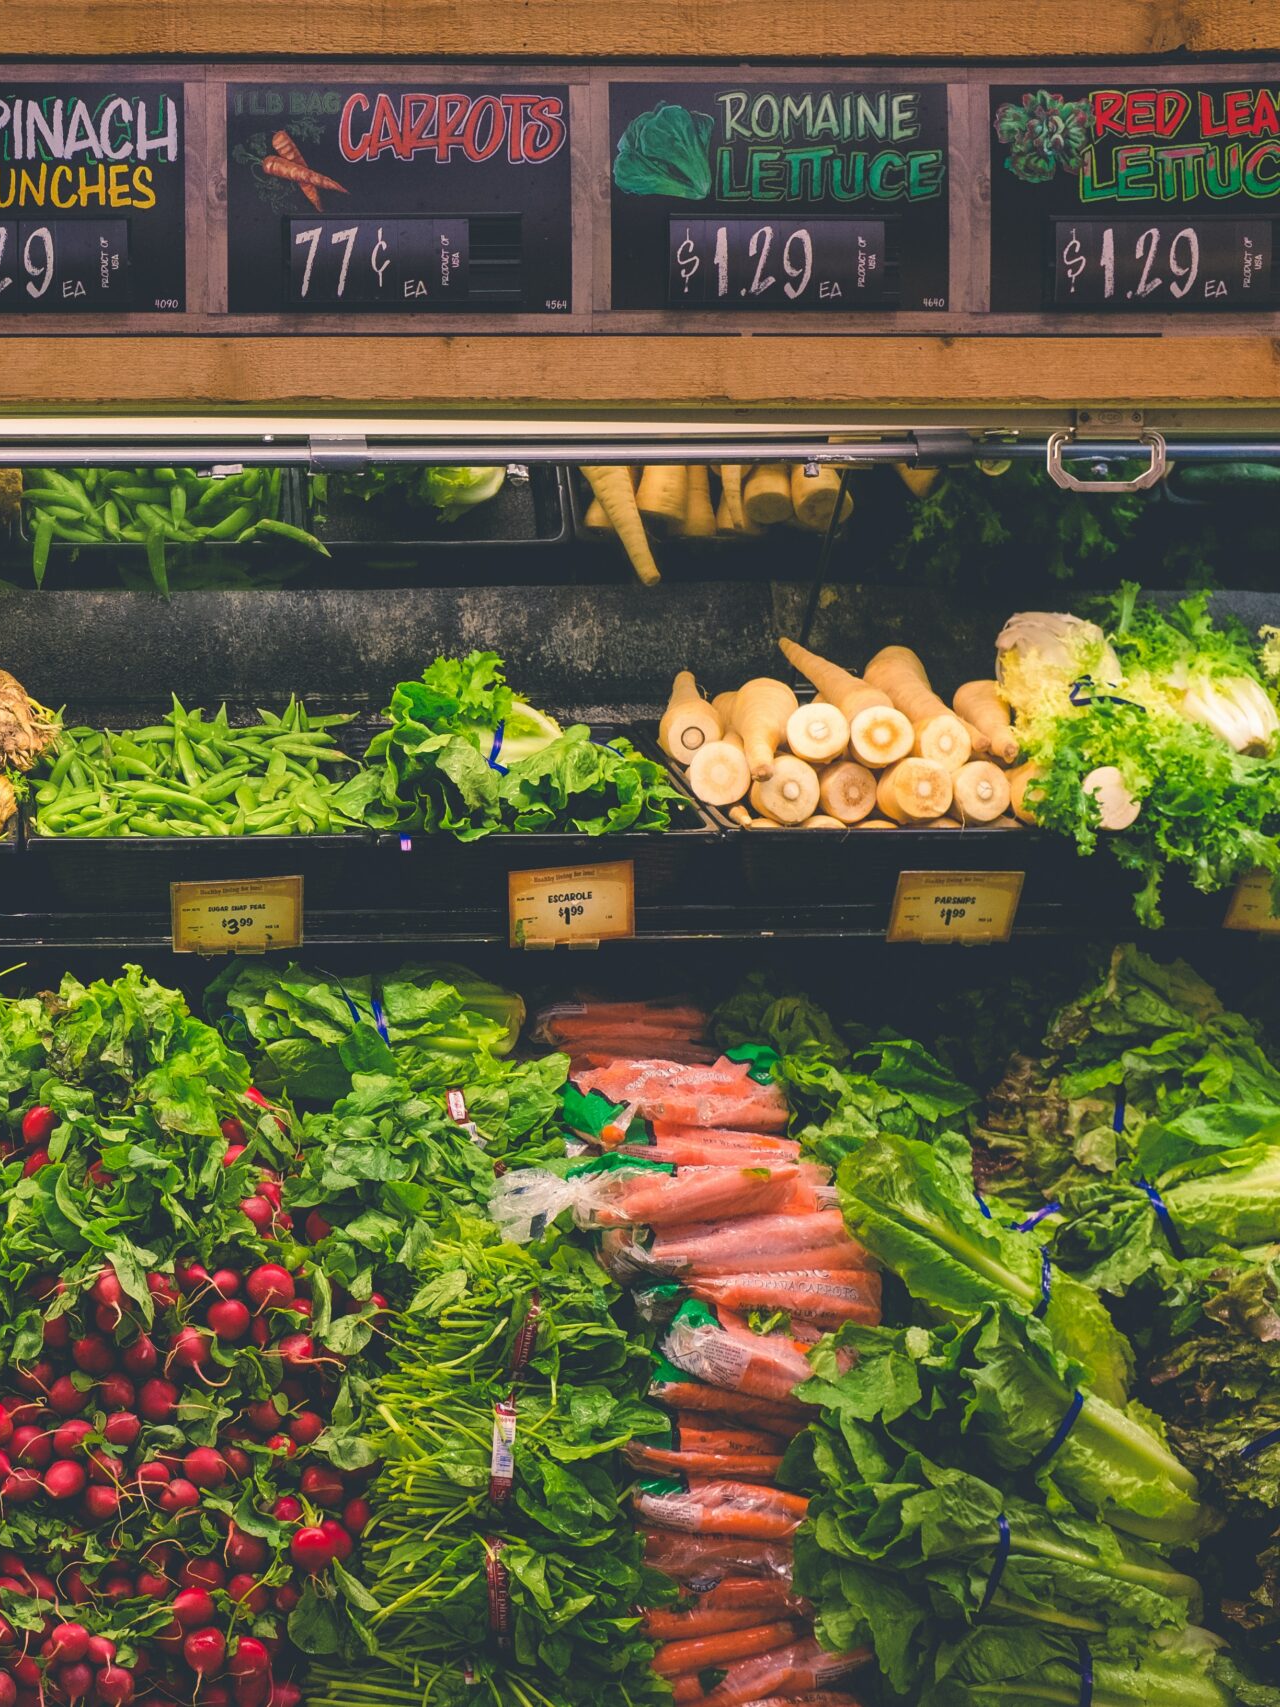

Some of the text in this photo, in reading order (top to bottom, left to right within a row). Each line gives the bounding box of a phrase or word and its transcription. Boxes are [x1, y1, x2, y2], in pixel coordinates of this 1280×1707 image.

[249, 90, 284, 114] LB
[288, 90, 341, 115] BAG
[716, 90, 919, 143] ROMAINE
[1090, 89, 1280, 140] RED LEA
[339, 93, 567, 164] CARROTS
[718, 147, 943, 201] LETTUCE
[1080, 143, 1280, 202] LETTUC
[100, 236, 109, 288] PRODUCT OF
[440, 234, 450, 286] PRODUCT OF
[451, 251, 460, 268] USA
[677, 226, 842, 299] $1.29 EA
[857, 236, 867, 288] PRODUCT OF
[868, 254, 877, 270] USA
[1063, 228, 1228, 299] $1.29 EA
[1243, 237, 1253, 288] PRODUCT OF
[1254, 254, 1263, 270] USA
[62, 281, 86, 298] EA
[155, 299, 179, 309] 4090
[404, 280, 428, 297] EA
[545, 300, 567, 310] 4564
[923, 298, 945, 308] 4640
[548, 891, 593, 903] ESCAROLE
[934, 896, 977, 905] PARSNIPS
